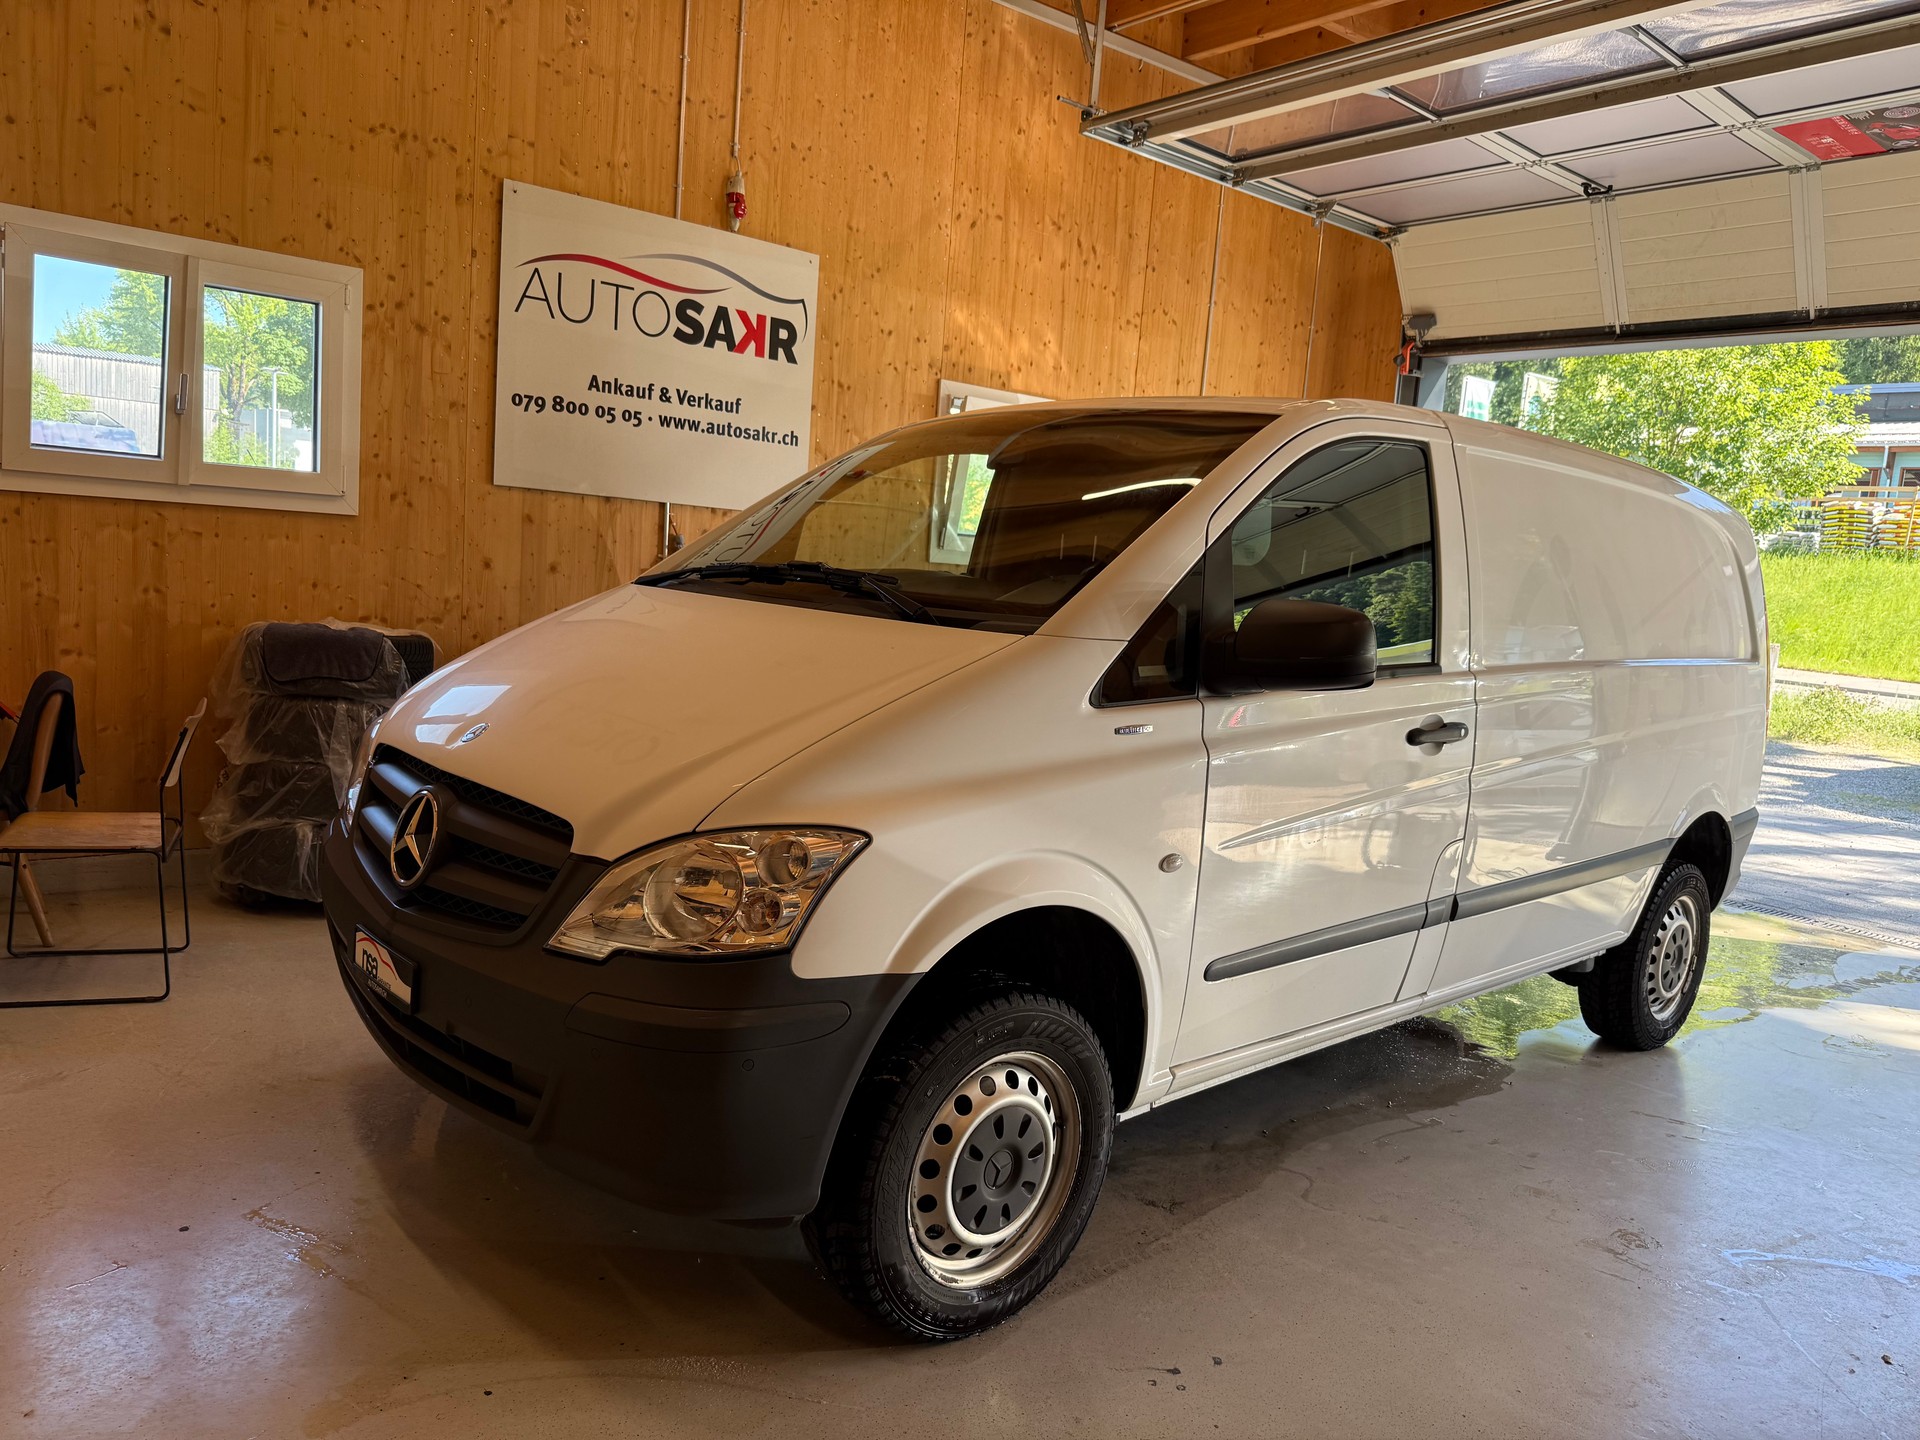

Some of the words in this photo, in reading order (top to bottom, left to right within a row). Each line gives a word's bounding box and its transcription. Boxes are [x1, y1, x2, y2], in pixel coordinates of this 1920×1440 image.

[587, 374, 655, 402] Ankauf
[658, 386, 673, 404] &
[675, 388, 742, 415] Verkauf
[510, 392, 547, 414] 079
[551, 394, 590, 417] 800
[594, 405, 617, 424] 05
[621, 409, 643, 428] 05
[658, 414, 800, 448] www.autosakr.ch
